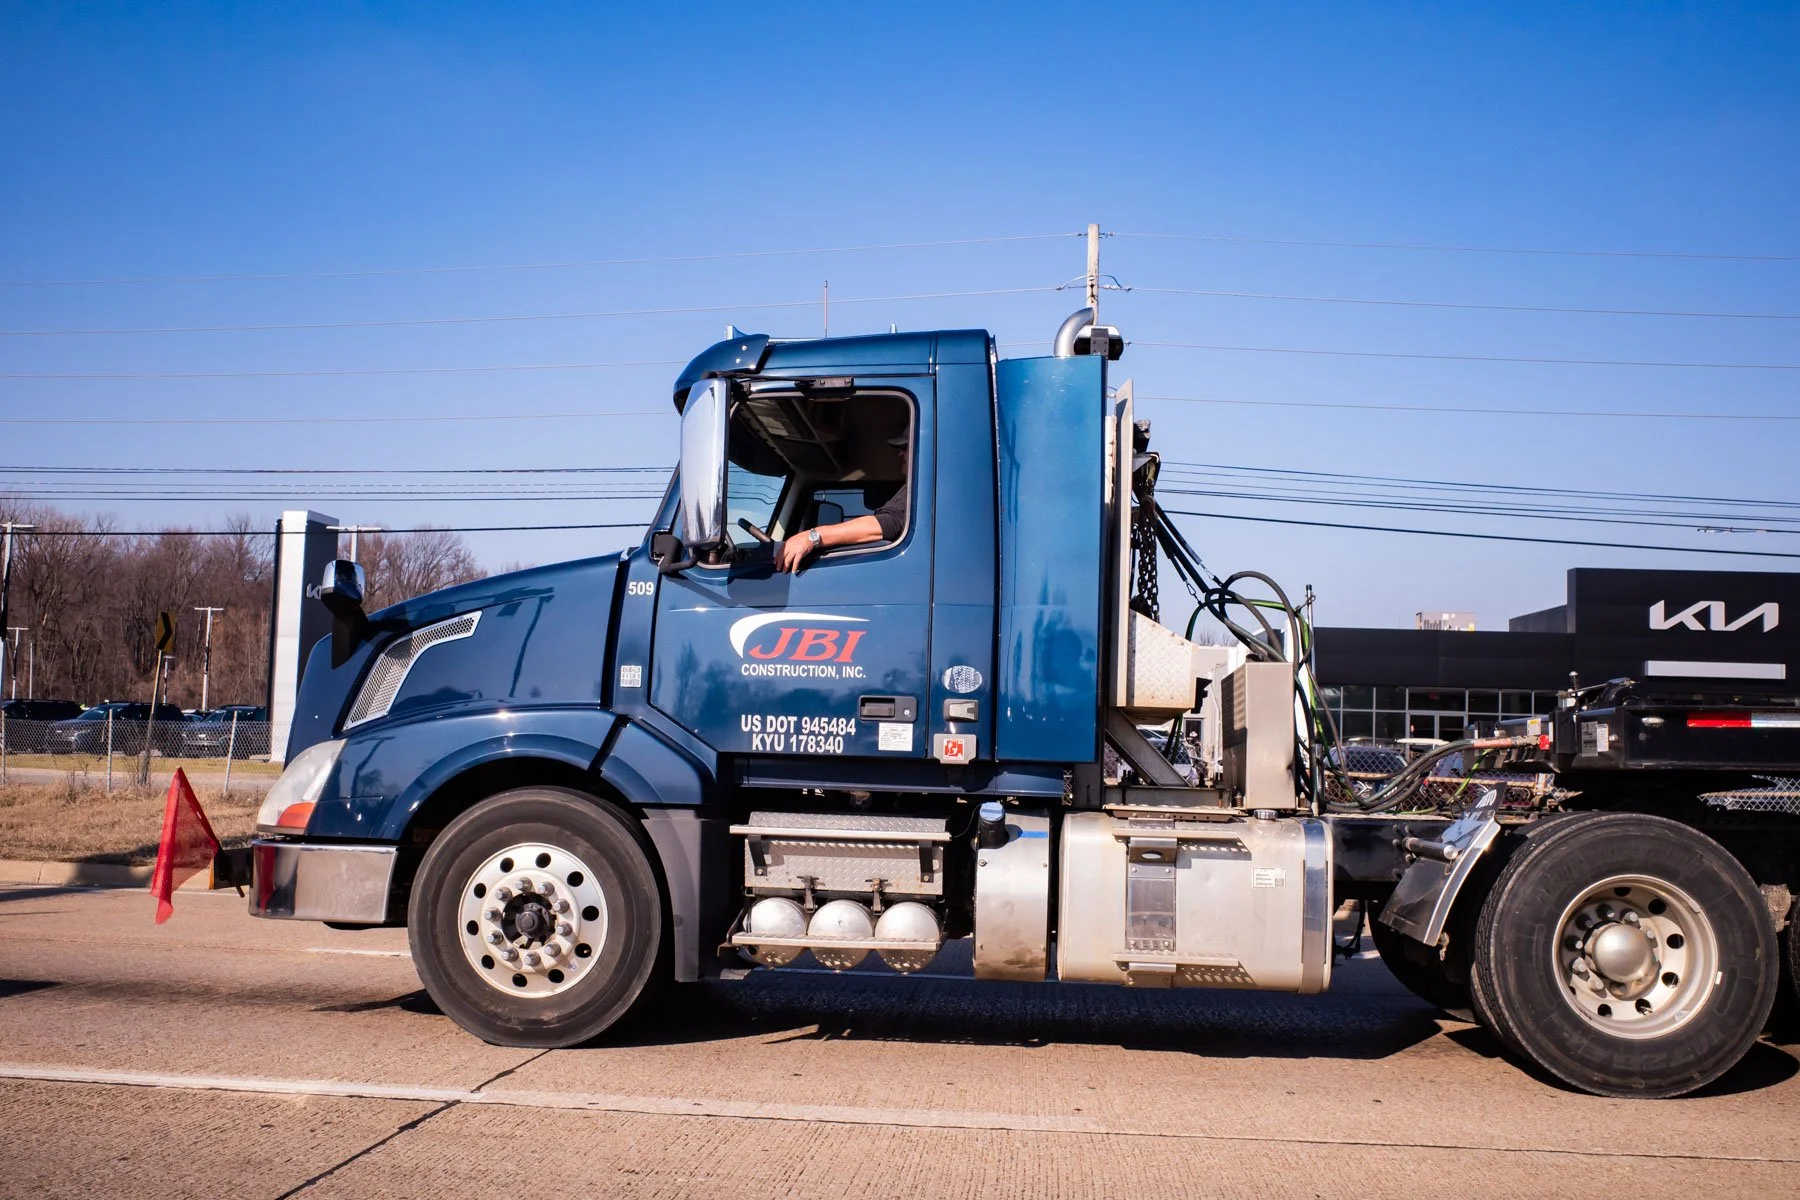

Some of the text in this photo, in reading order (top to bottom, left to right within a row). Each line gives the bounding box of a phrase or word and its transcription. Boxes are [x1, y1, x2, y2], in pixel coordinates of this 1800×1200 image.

[628, 581, 655, 596] 509
[747, 627, 867, 663] JBI
[741, 663, 867, 680] CONSTRUCTION, INC.
[741, 714, 857, 736] US DOT 945484
[752, 733, 844, 754] KYU 178340
